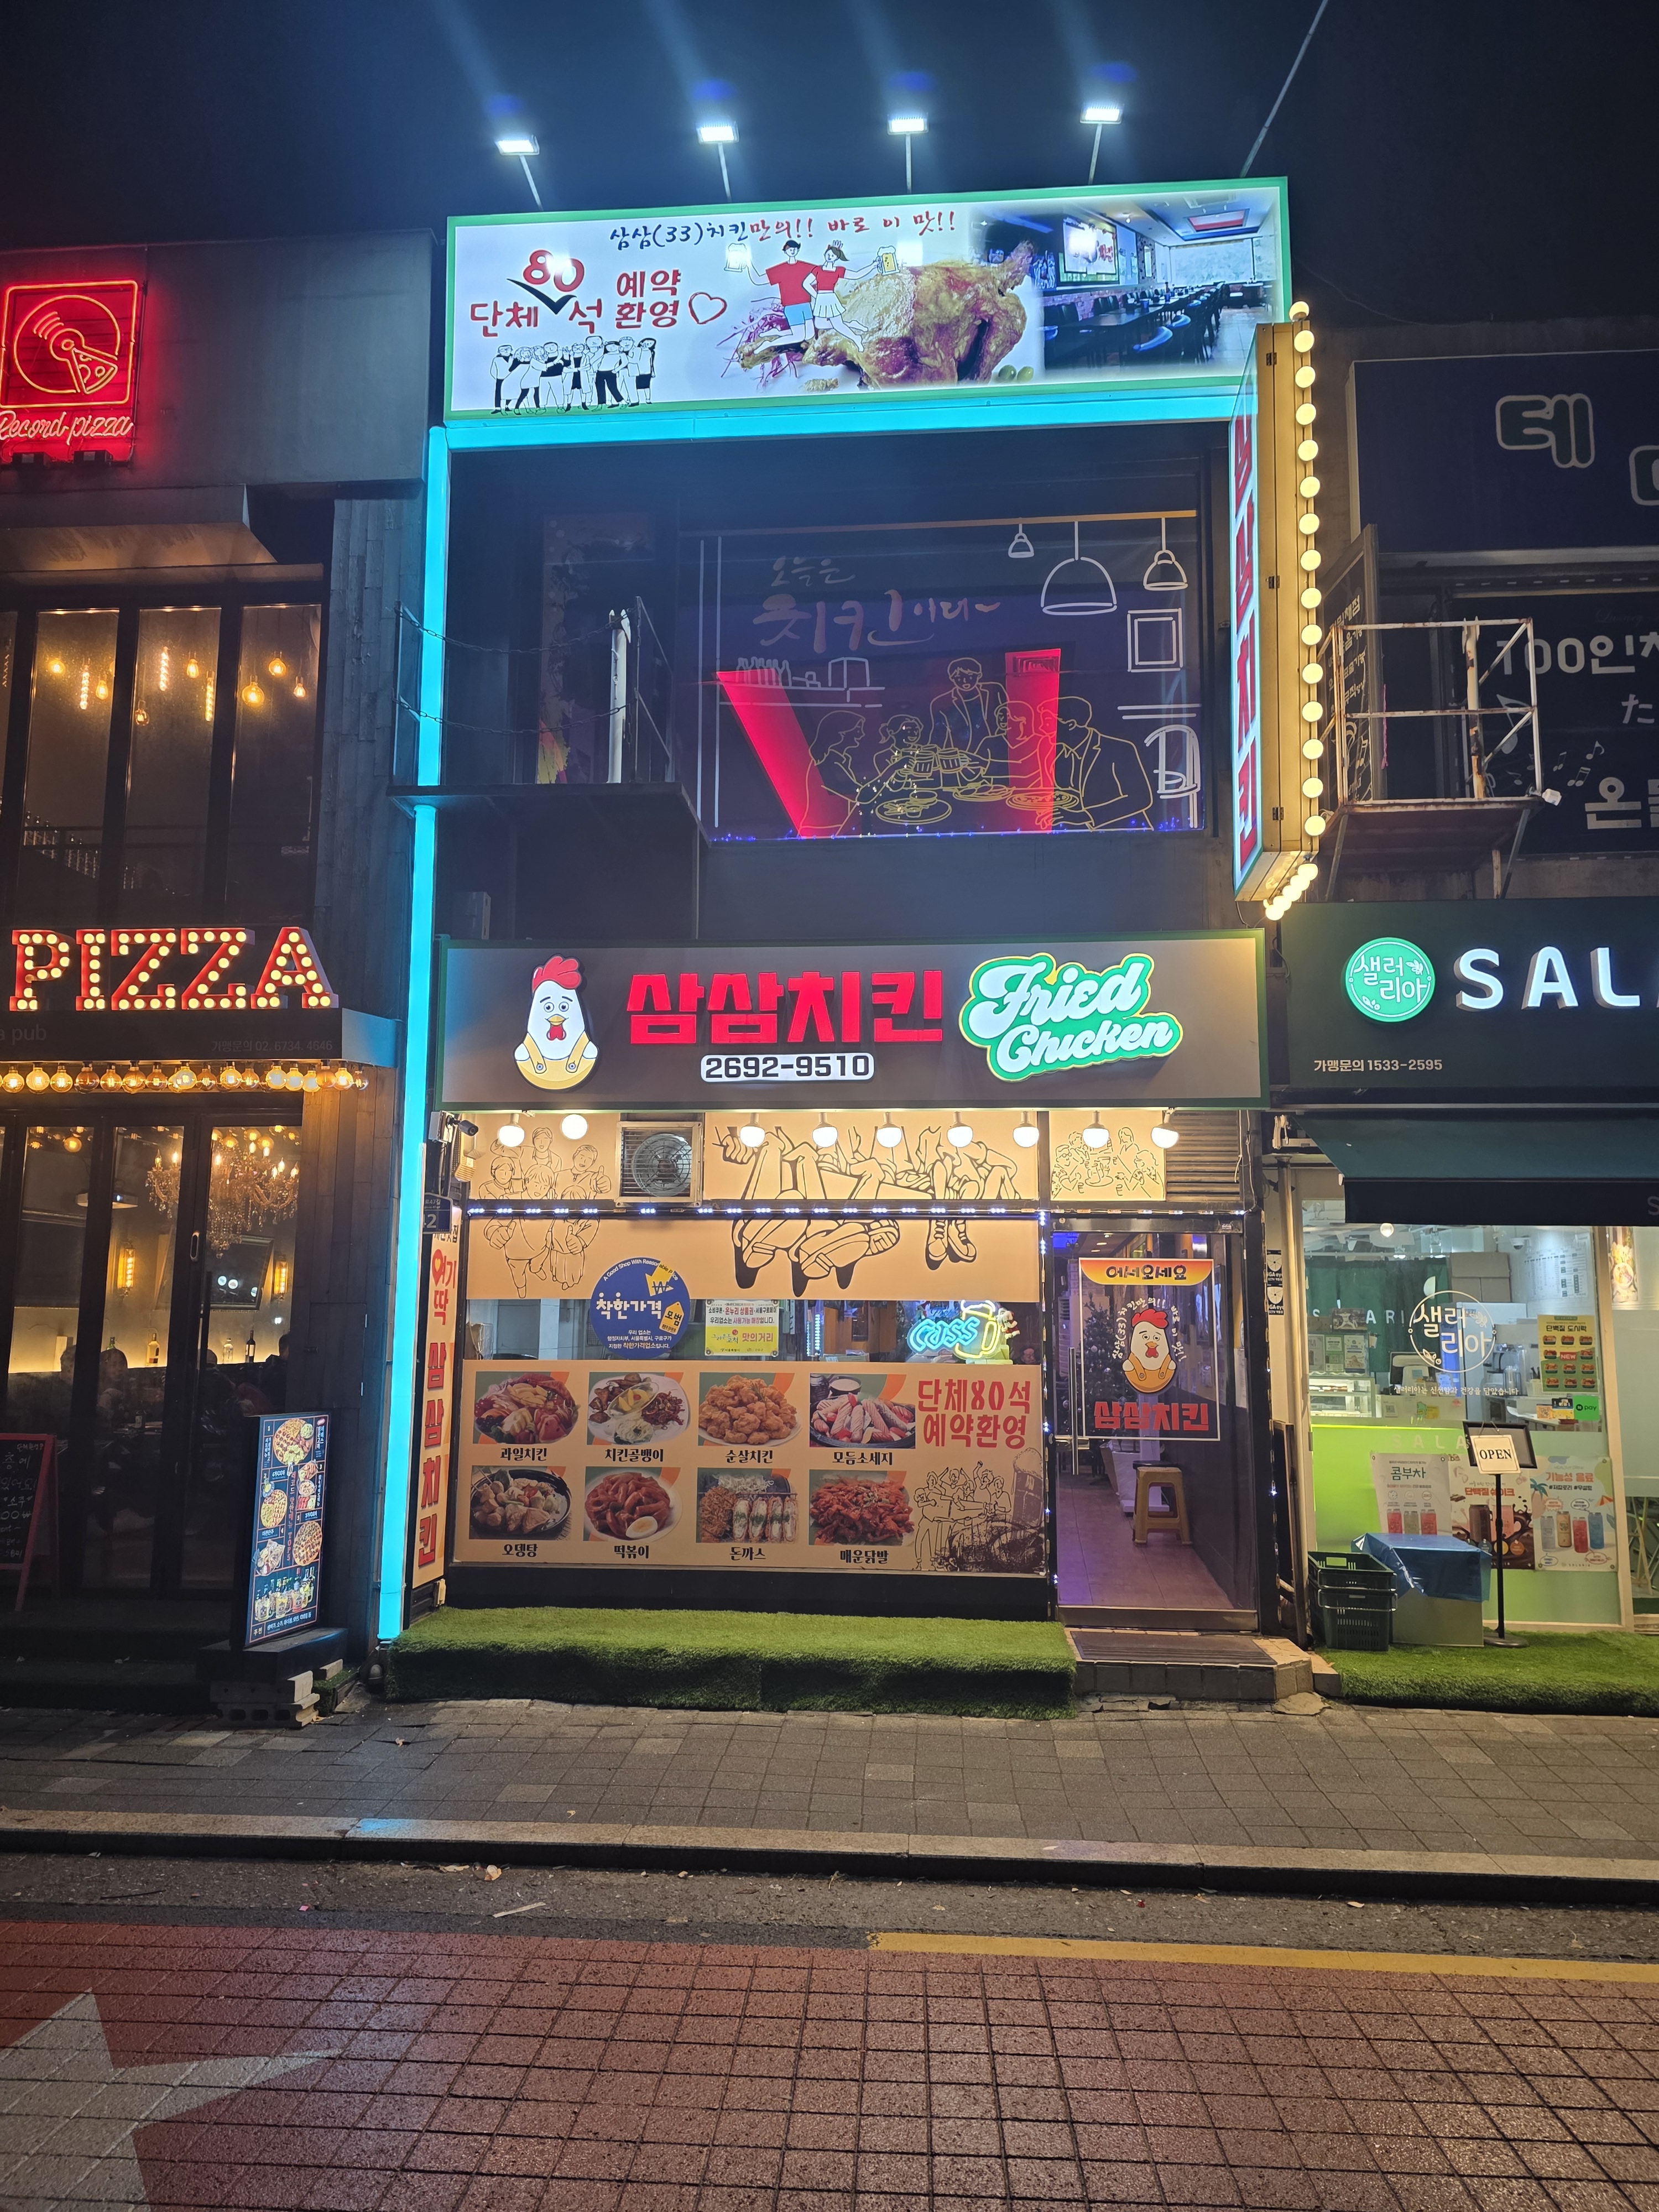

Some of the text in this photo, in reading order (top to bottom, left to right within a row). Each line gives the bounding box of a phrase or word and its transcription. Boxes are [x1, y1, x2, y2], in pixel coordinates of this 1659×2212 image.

[828, 216, 870, 233] 바로
[884, 216, 900, 228] 이
[913, 211, 956, 236] 맛!!
[523, 249, 585, 292] 80
[616, 269, 681, 298] 예약
[470, 299, 680, 337] 단체 석 환영
[0, 411, 134, 446] Record pizza
[771, 555, 855, 587] 오늘은
[9, 926, 336, 1011] PIZZA
[1354, 954, 1404, 987] 샐러
[1455, 946, 1659, 1010] SAL
[968, 962, 1146, 1039] Fried
[1379, 978, 1428, 1004] 리아
[626, 970, 944, 1045] 삼삼치킨
[12, 1025, 47, 1045] pub
[211, 1040, 253, 1052] 가맹문의
[306, 1040, 333, 1051] 4646
[996, 1020, 1173, 1073] Chicken
[705, 1055, 870, 1079] 2692-9510
[1313, 1059, 1443, 1072] 가맹문의 1533-2595
[607, 1266, 619, 1277] Good
[618, 1261, 630, 1270] Shop
[1105, 1264, 1187, 1280] 어서오세요
[433, 1288, 449, 1326] 딱
[596, 1292, 662, 1320] 착한가격
[725, 1307, 739, 1316] 온누리
[1171, 1305, 1180, 1324] 바로
[665, 1311, 682, 1327] 모범
[1413, 1303, 1465, 1338] 샐러
[742, 1333, 774, 1343] 맛의거리
[1441, 1329, 1492, 1359] 리아
[917, 1379, 1031, 1414] 단체80석
[1394, 1386, 1428, 1395] 샐러리아는
[1460, 1386, 1481, 1395] 건강을
[1483, 1387, 1519, 1396] 담았습니다
[1094, 1401, 1209, 1431] 삼삼치킨
[923, 1413, 1026, 1449] 예약환영
[418, 1342, 446, 1568] 삼삼치킨
[499, 1447, 548, 1462] 과일치킨
[604, 1447, 664, 1463] 치킨골뱅이
[724, 1449, 774, 1464] 순살치킨
[832, 1451, 894, 1466] 모듬소세지
[1479, 1449, 1512, 1459] OPEN
[1390, 1467, 1426, 1480] 콤부차
[1546, 1472, 1594, 1483] 기능성 음료
[1464, 1487, 1490, 1496] 단백질
[502, 1543, 539, 1558] 오뎅탕
[614, 1545, 650, 1559] 떡볶이
[729, 1547, 767, 1561] 돈까스
[839, 1550, 889, 1564] 매운닭발
